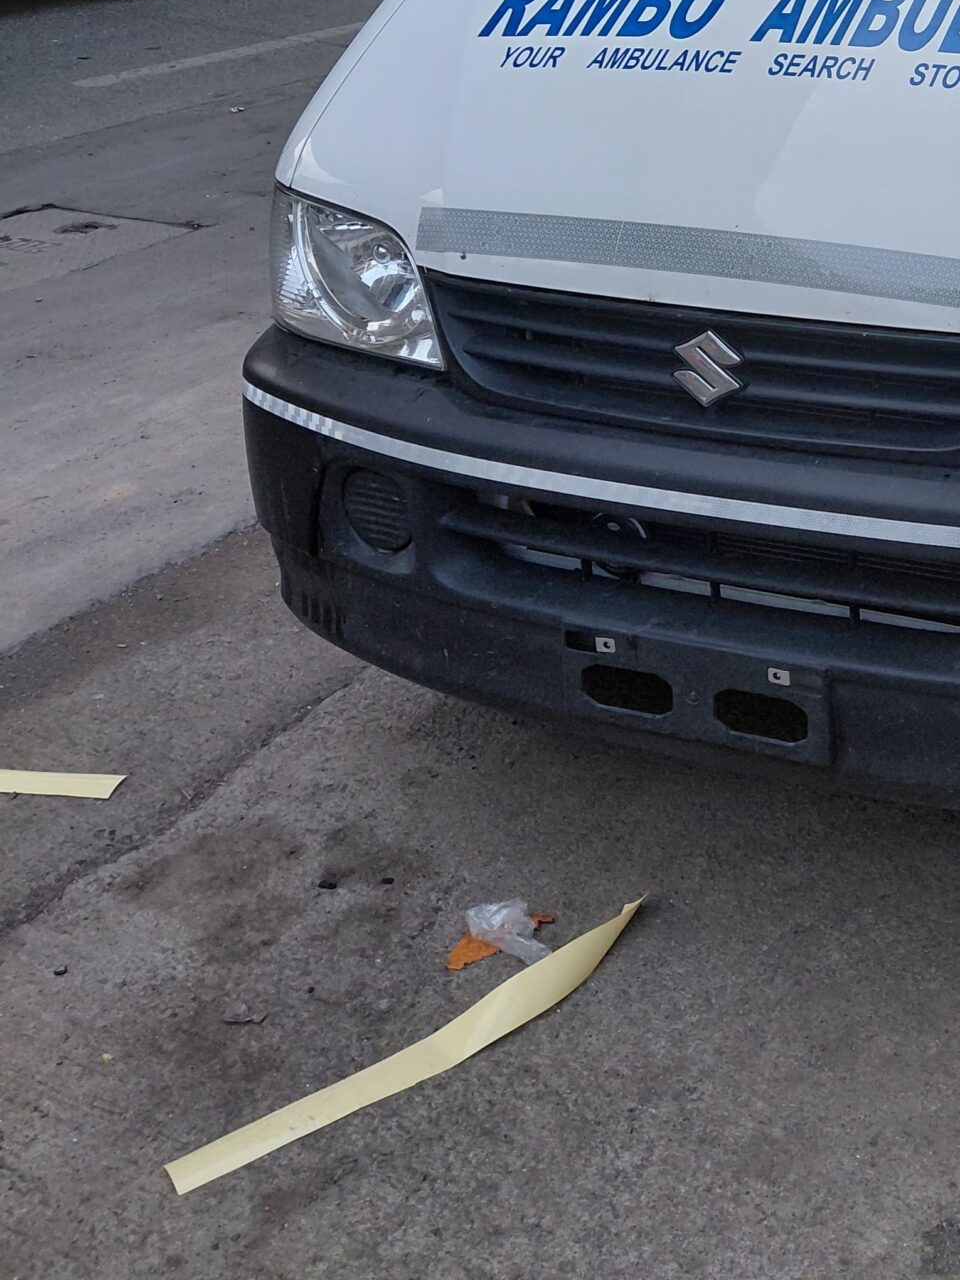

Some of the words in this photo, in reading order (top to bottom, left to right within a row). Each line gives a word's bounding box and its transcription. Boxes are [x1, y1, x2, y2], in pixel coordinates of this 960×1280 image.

[498, 45, 567, 69] YOUR
[586, 48, 742, 75] AMBULANCE
[767, 53, 876, 82] SEARCH
